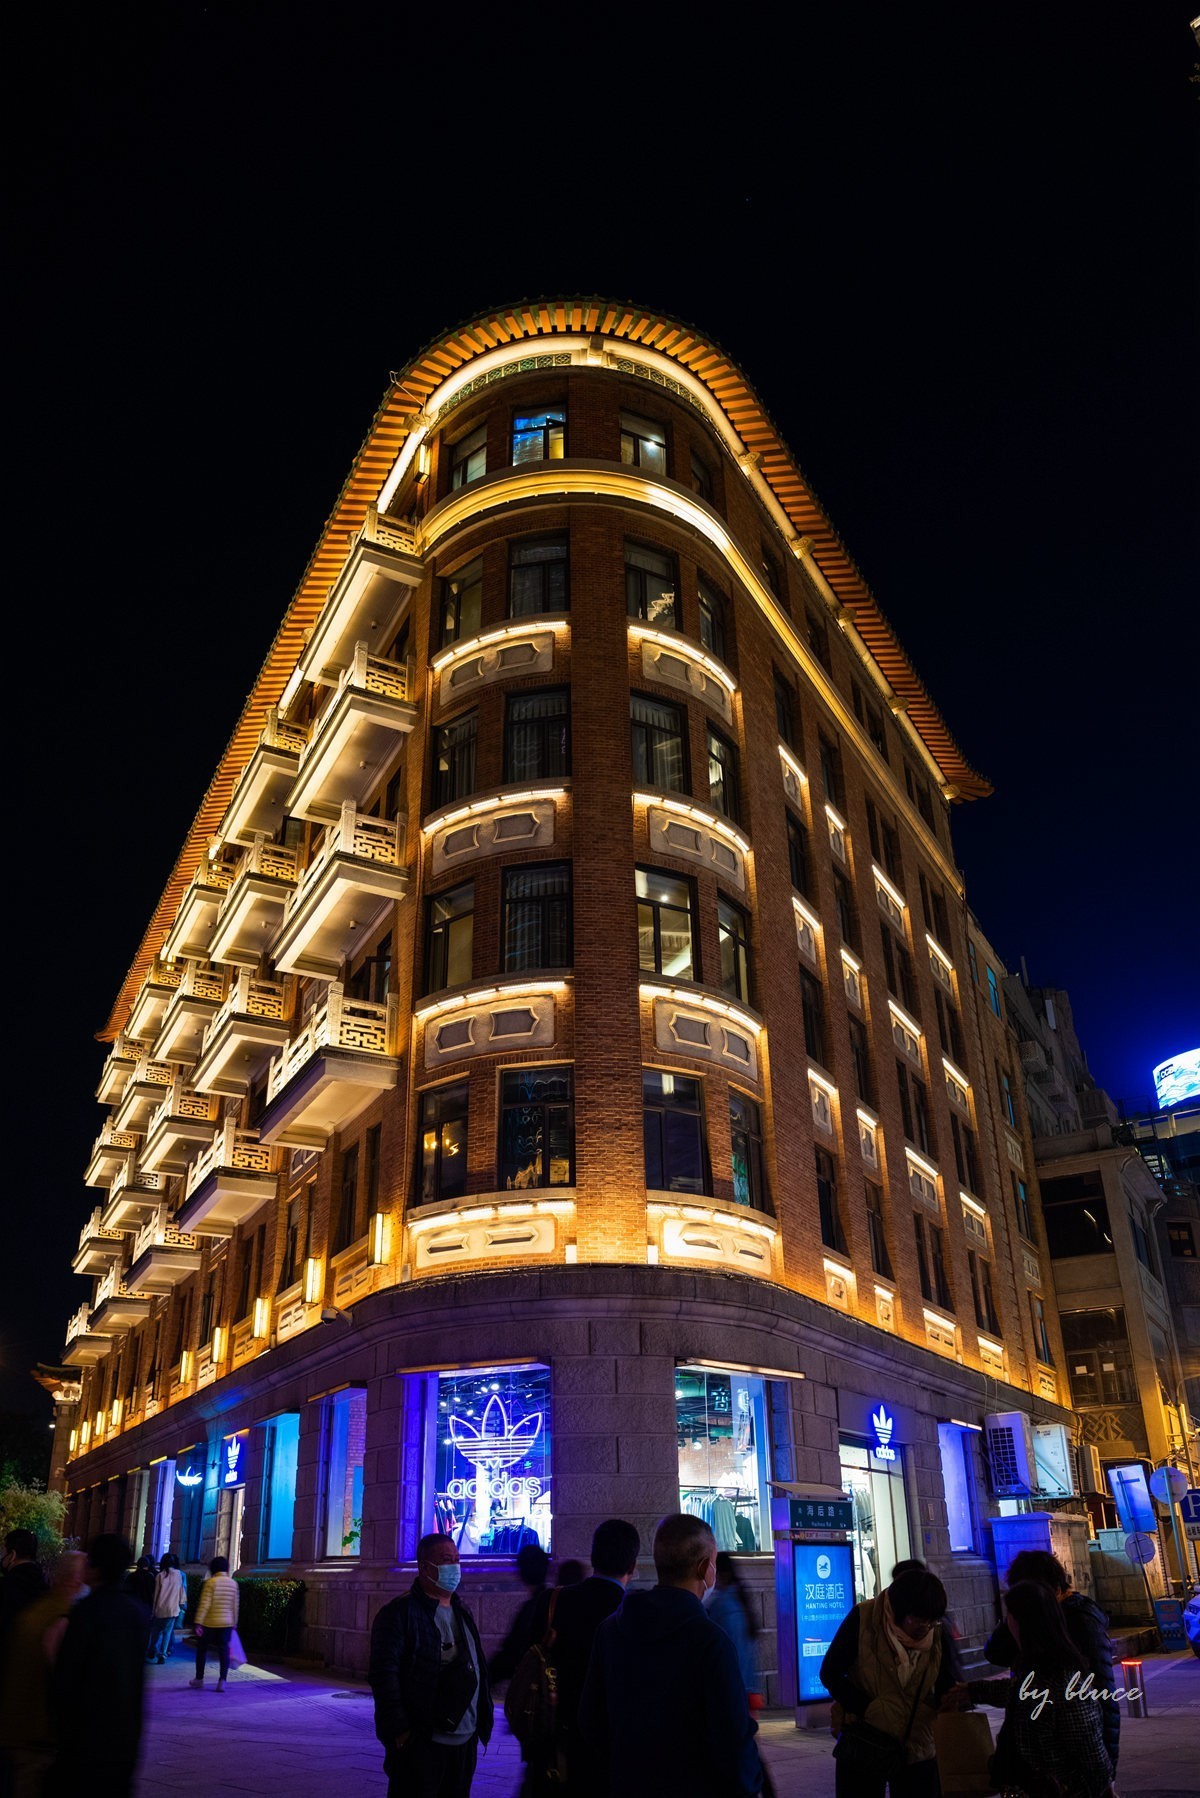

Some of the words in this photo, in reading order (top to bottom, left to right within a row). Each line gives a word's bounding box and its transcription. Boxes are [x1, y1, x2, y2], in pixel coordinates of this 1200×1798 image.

[447, 1472, 541, 1499] adas
[806, 1504, 835, 1517] 海后路
[1186, 1493, 1200, 1518] P
[805, 1583, 845, 1600] 汉庭酒店
[829, 1601, 845, 1609] HOTEL
